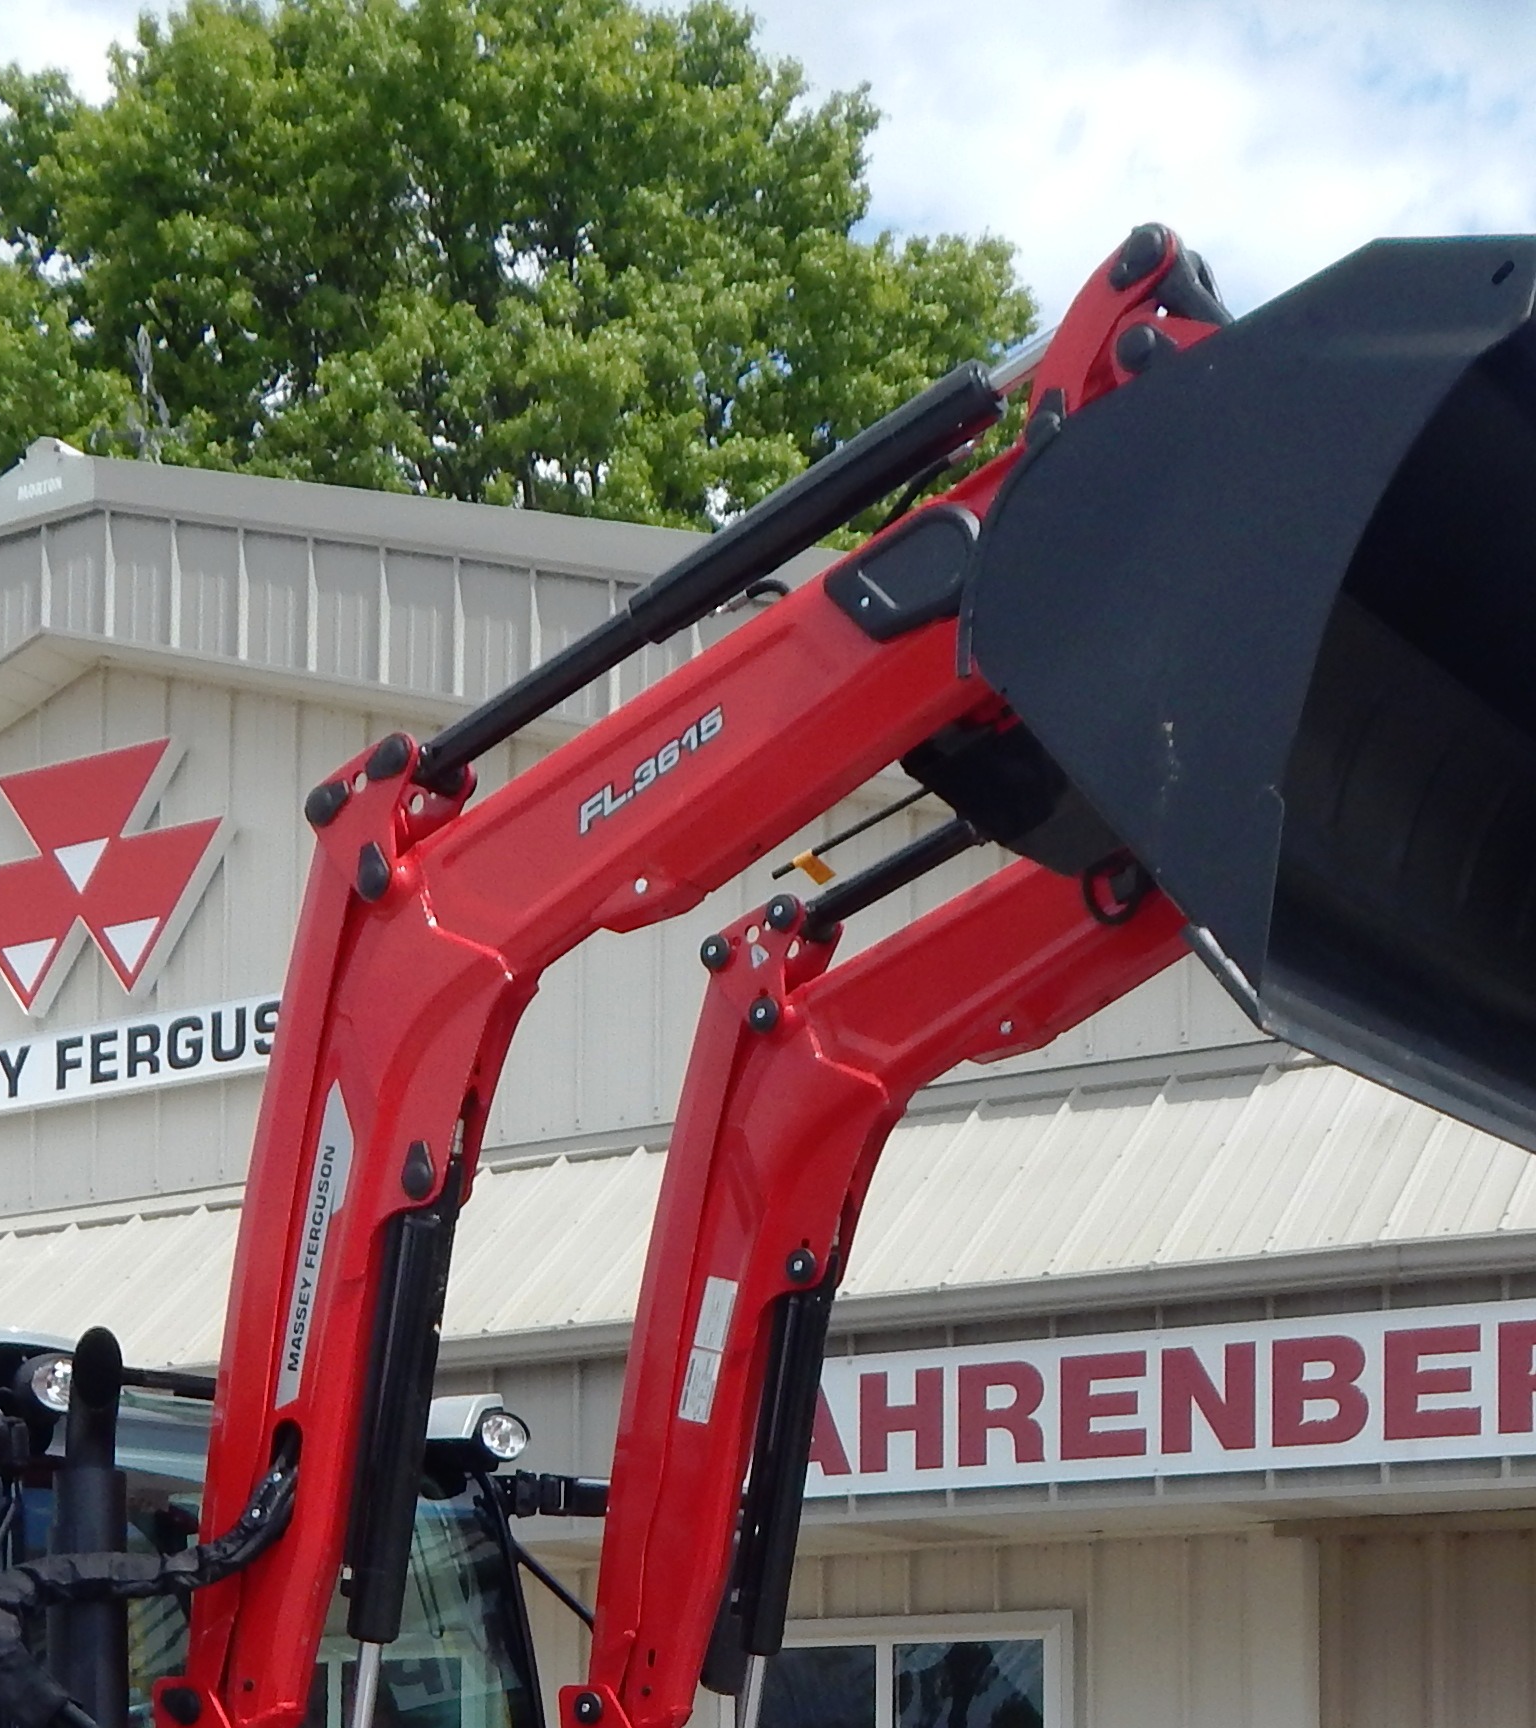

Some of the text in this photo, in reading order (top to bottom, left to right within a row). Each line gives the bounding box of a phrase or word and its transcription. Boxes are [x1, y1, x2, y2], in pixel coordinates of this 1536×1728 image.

[579, 703, 724, 835] FL.3615
[287, 1145, 336, 1372] MASSEY FERGUSON
